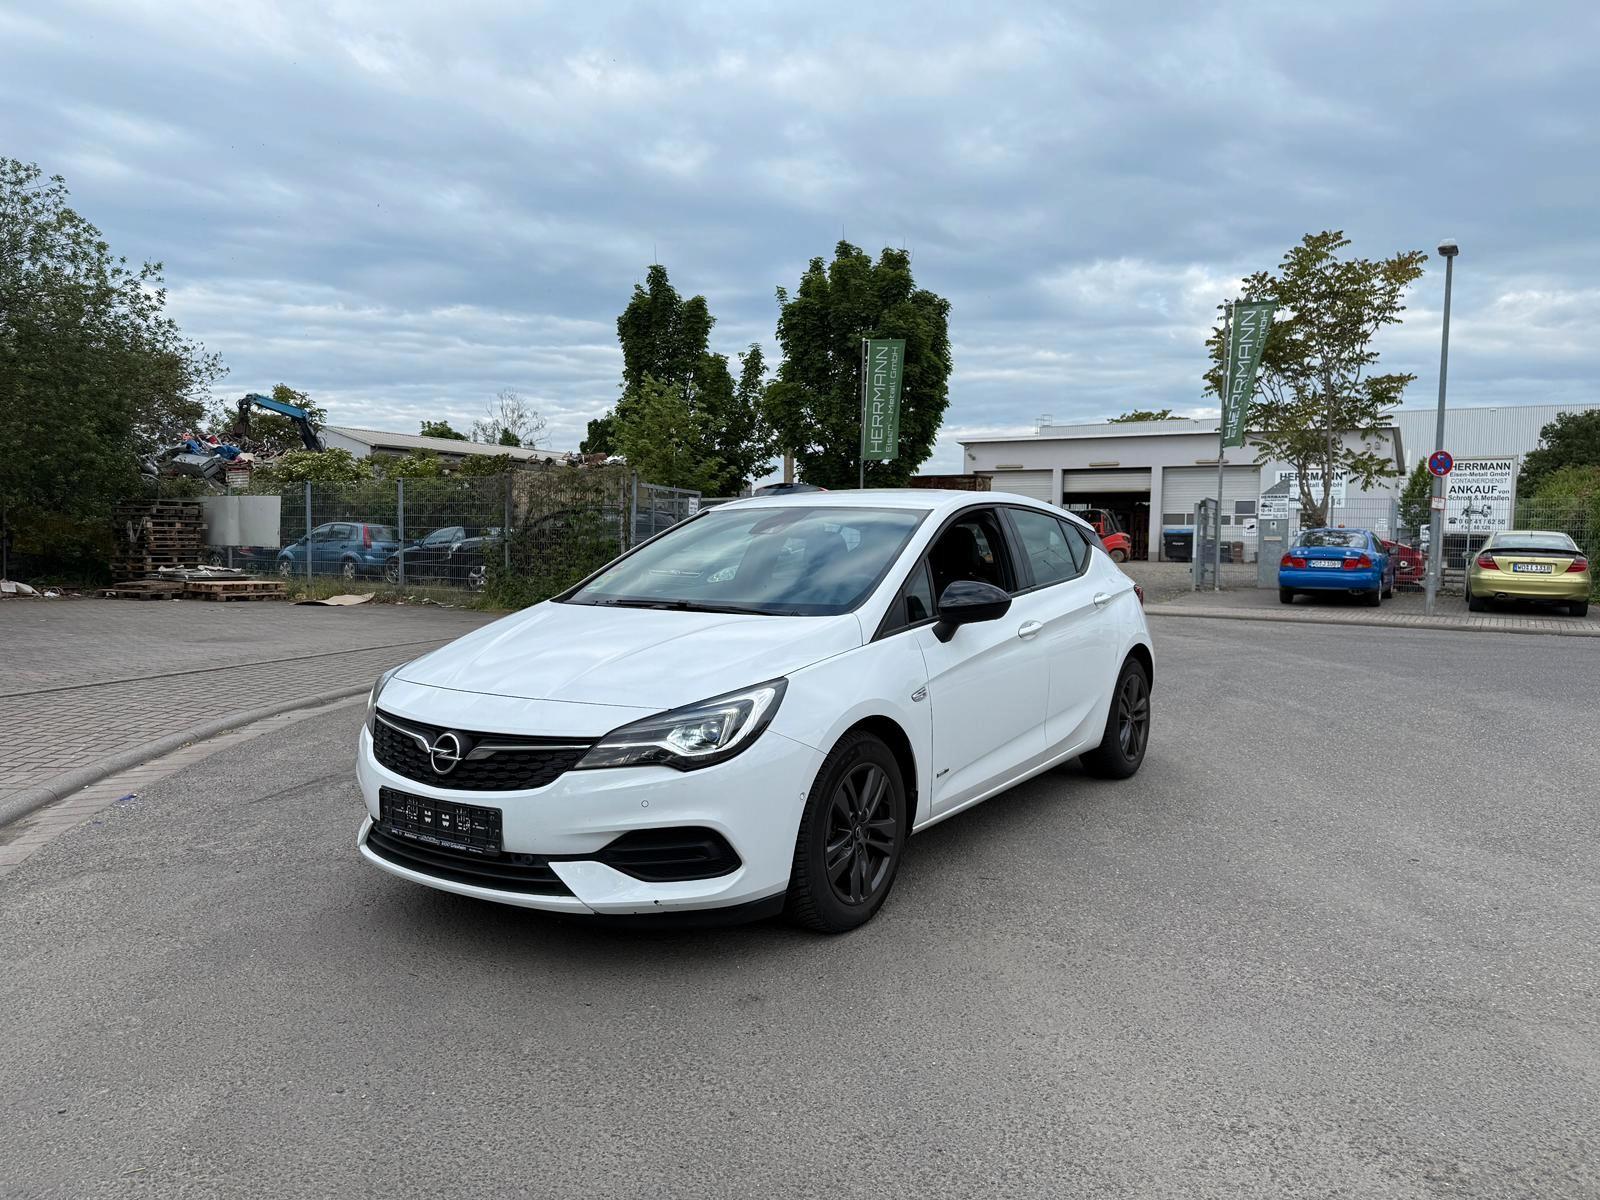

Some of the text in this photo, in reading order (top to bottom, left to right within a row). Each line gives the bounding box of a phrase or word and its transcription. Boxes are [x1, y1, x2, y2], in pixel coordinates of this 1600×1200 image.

[890, 346, 898, 379] GmbH
[1224, 310, 1257, 439] HERRMANN
[870, 346, 888, 453] HERRMANN
[888, 381, 896, 414] Metall
[1453, 462, 1511, 471] HERRMANN
[1449, 485, 1498, 494] ANKAUF
